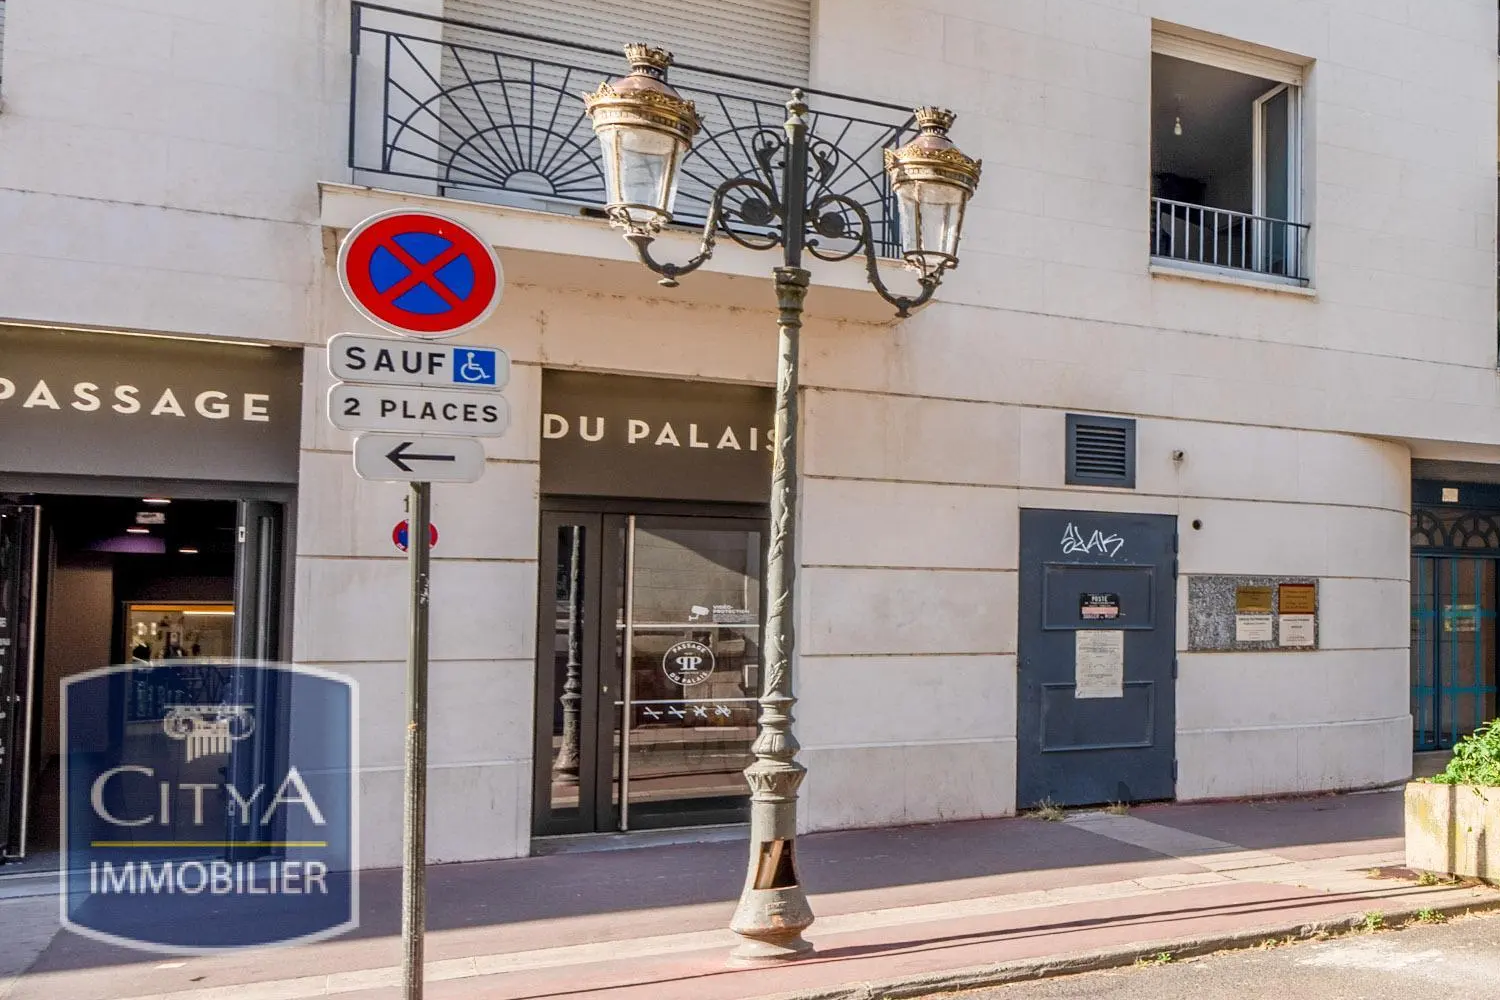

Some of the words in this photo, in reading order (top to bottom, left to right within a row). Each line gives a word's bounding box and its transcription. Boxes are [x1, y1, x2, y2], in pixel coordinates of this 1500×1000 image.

[345, 346, 446, 375] SAUF
[343, 397, 361, 416] 2
[380, 399, 498, 423] PLACES
[542, 413, 605, 442] DU
[672, 643, 706, 654] PASSAGE
[669, 672, 680, 681] DU
[681, 671, 708, 684] PALAIS
